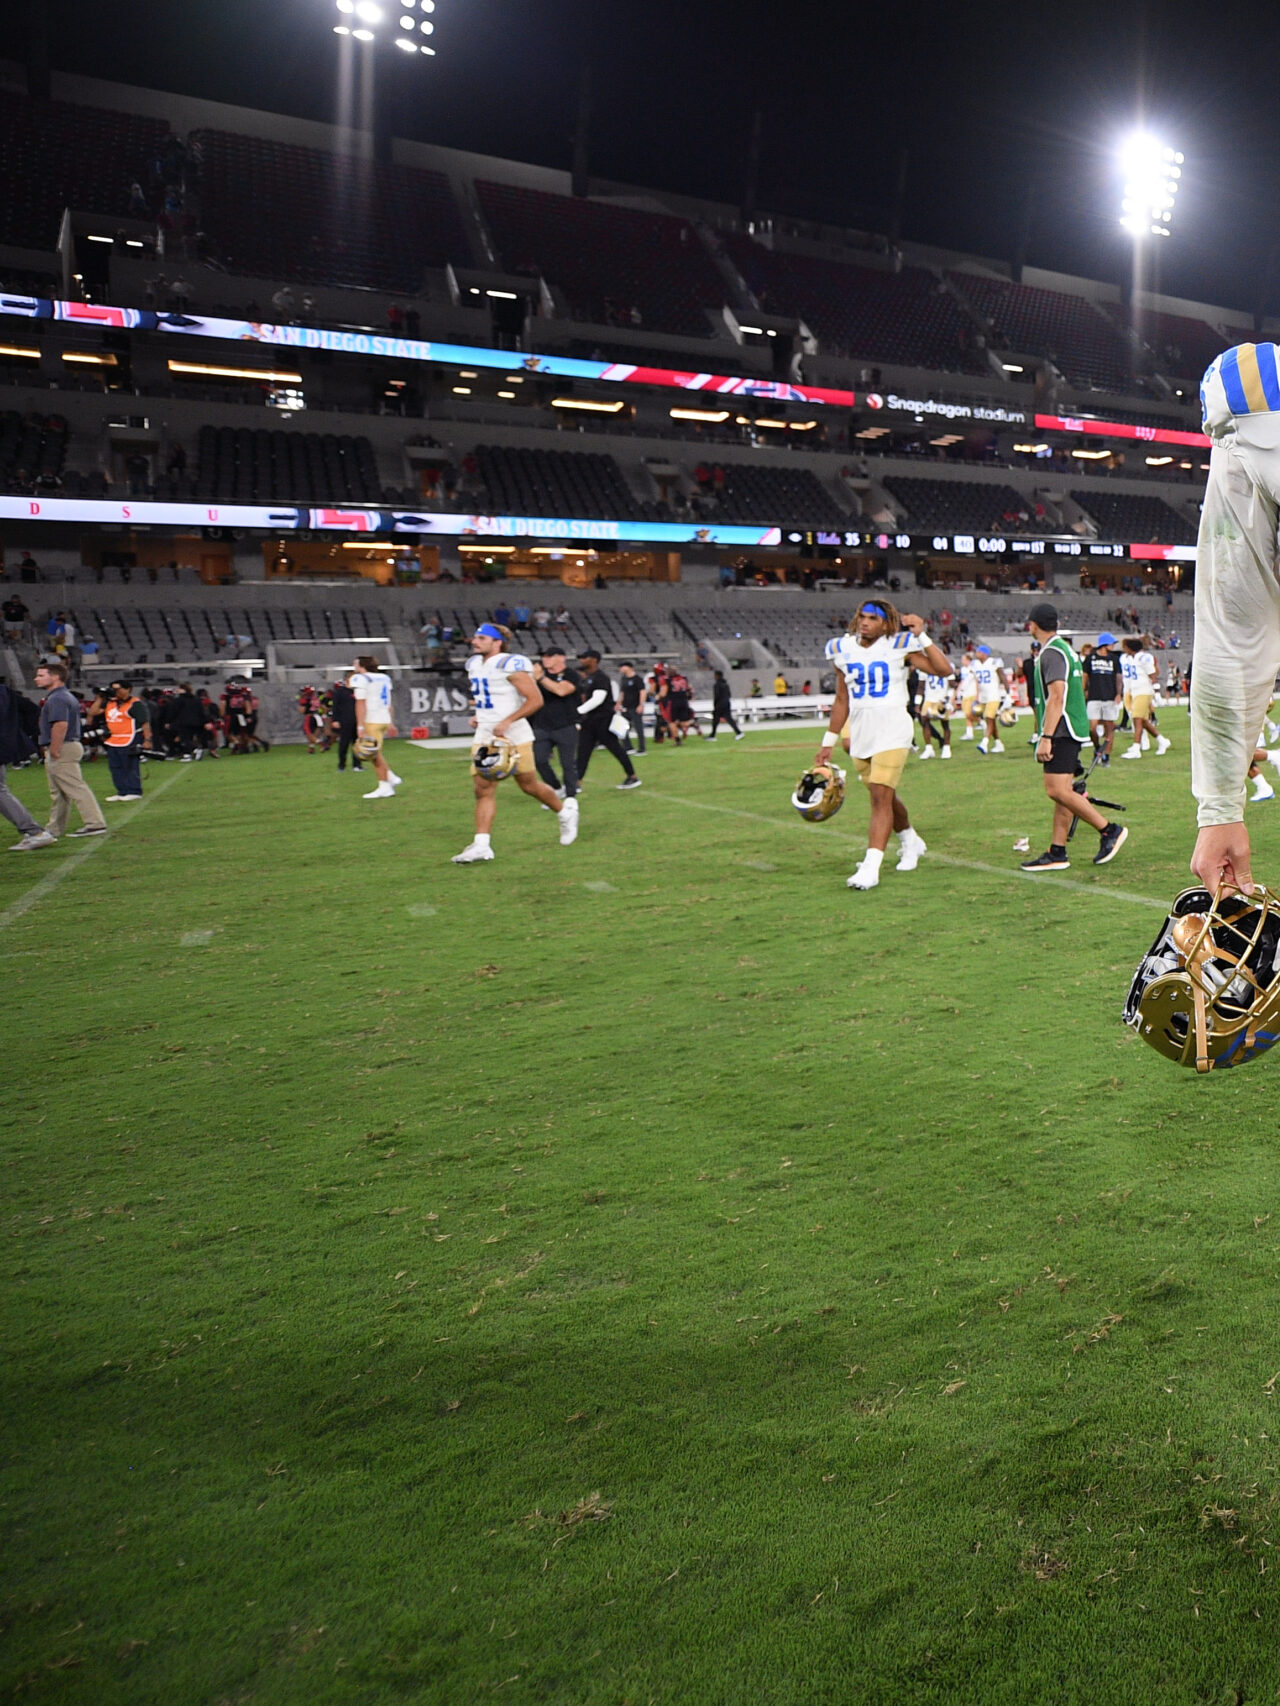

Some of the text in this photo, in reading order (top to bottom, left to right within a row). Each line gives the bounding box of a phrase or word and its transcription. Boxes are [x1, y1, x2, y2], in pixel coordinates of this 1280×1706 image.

[258, 323, 433, 361] SAN DIEGO STATE
[886, 394, 1026, 424] Snapdragon stadium
[29, 502, 219, 522] D S U
[476, 515, 619, 540] SAN DIEGO STATE
[844, 531, 861, 547] 35
[895, 534, 911, 549] 10
[978, 537, 1006, 553] 0:00
[846, 660, 890, 699] 30
[927, 674, 945, 690] 24
[975, 669, 992, 684] 32
[410, 686, 475, 713] BAS
[470, 677, 494, 709] 21
